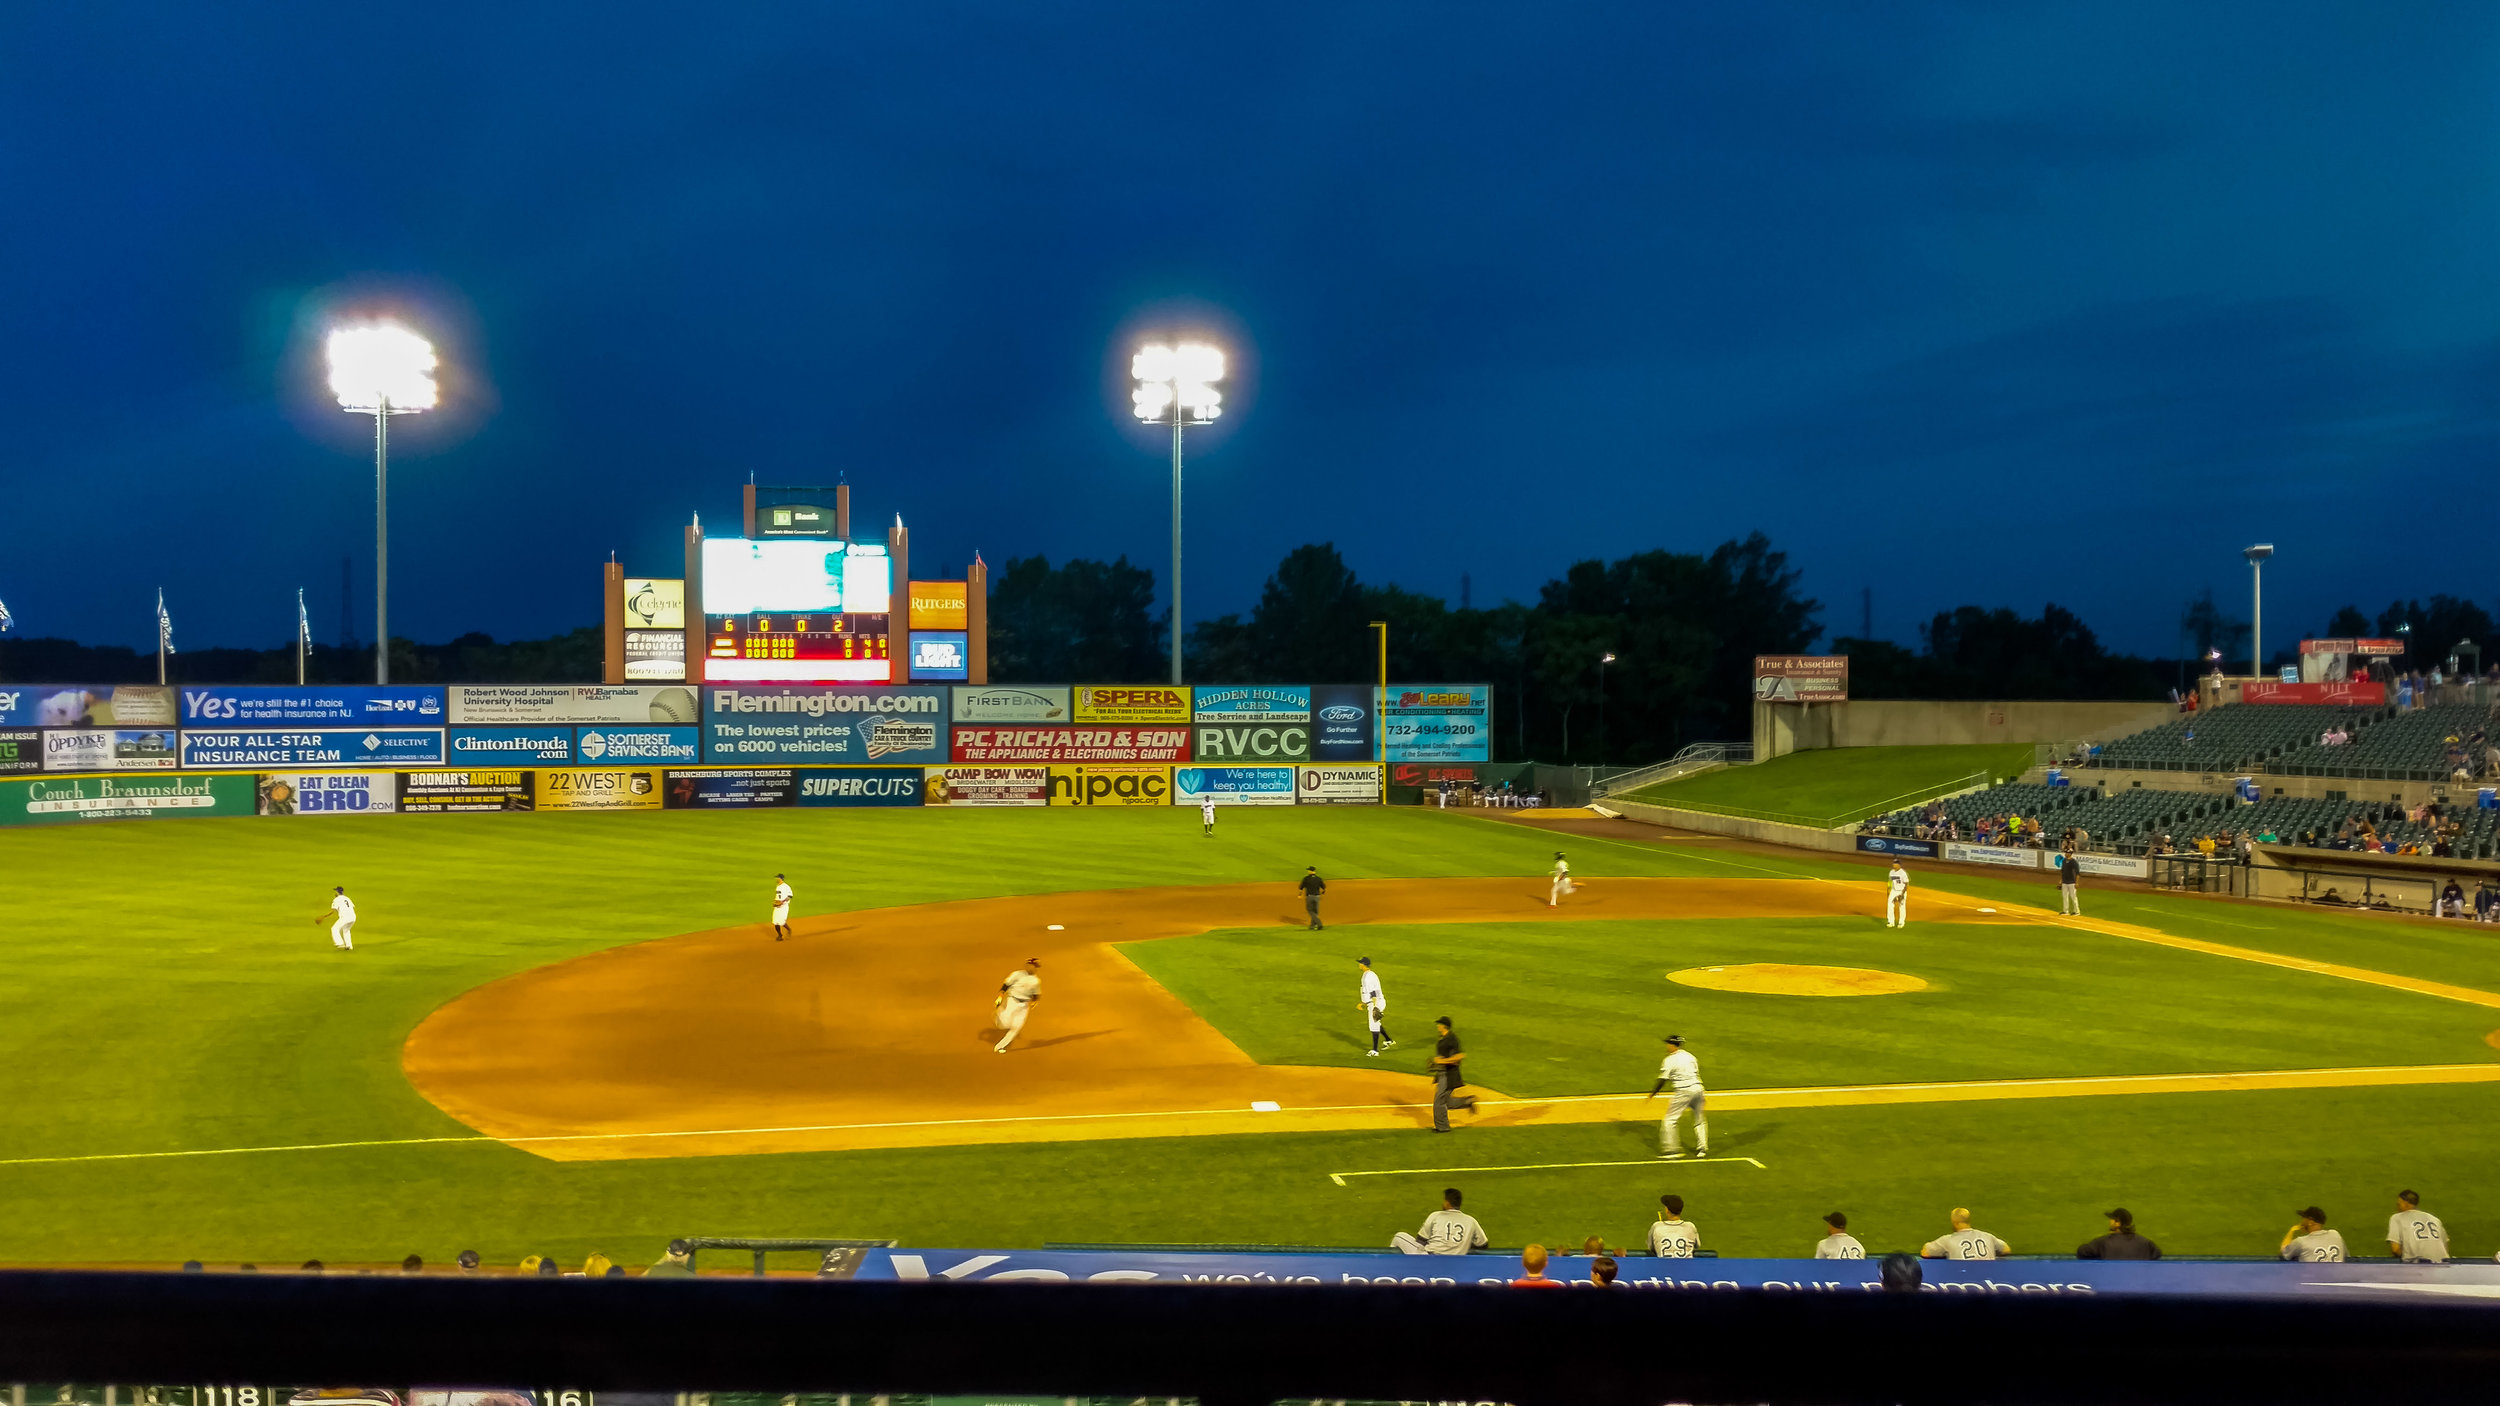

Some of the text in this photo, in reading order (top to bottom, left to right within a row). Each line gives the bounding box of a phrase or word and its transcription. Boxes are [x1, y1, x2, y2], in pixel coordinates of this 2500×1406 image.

[795, 512, 819, 521] Bank
[911, 597, 966, 612] RUTGERS
[834, 619, 843, 632] 2
[641, 634, 684, 643] FINANCIAL
[626, 643, 684, 651] RESOURCES
[1759, 659, 1844, 669] True & Associates
[463, 688, 569, 696] Robert Wood Johnson
[1093, 690, 1185, 705] SPERA
[184, 691, 344, 719] Yes we're still the #1 choice
[463, 697, 554, 706] University Hospital
[713, 690, 939, 717] Flemington.com
[1197, 689, 1309, 709] HIDDEN HOLLOW
[1235, 701, 1271, 710] ACRES
[240, 709, 338, 718] for health insurance in
[1266, 713, 1309, 721] Landscape
[1328, 708, 1356, 720] Ford
[715, 724, 851, 738] The lowest prices
[874, 726, 933, 736] Flemington
[1387, 725, 1475, 735] 732-494-9200
[49, 734, 105, 752] OPDYKE
[194, 736, 321, 747] YOUR ALL-STAR
[454, 737, 568, 750] ClintonHonda
[608, 734, 671, 745] SOMERSET
[995, 731, 1111, 746] RICHARD
[1113, 731, 1133, 746] &
[1135, 731, 1186, 746] SON
[1200, 728, 1307, 756] RVCC
[608, 745, 694, 756] SAVINGS BANK
[714, 740, 848, 753] on 6000 vehicles!
[194, 750, 340, 762] INSURANCE TEAM
[537, 750, 568, 758] .com
[965, 749, 1177, 759] THE APPLIANCE & ELECTRONICS GIANT!
[410, 772, 521, 785] BODNAR'S AUCTION
[944, 768, 1045, 780] CAMP BOW WOW
[1225, 768, 1288, 779] We're here to
[1322, 771, 1376, 780] DYNAMIC
[299, 776, 369, 789] EAT CLEAN
[549, 773, 626, 790] 22 WEST
[750, 779, 790, 787] just sports
[801, 778, 915, 796] SUPERCUTS
[1050, 767, 1166, 805] njpac
[1213, 779, 1236, 791] keep
[1238, 783, 1255, 791] you
[29, 777, 213, 801] Couch Braunsdorf
[40, 798, 200, 811] INSURANCE
[299, 789, 393, 811] BRO .COM
[1122, 797, 1159, 805] njpac.org
[1446, 1222, 1464, 1243] 13
[2413, 1221, 2440, 1239] 26
[1661, 1238, 1687, 1257] 29
[1960, 1239, 1987, 1259] 20
[204, 1386, 260, 1406] 118
